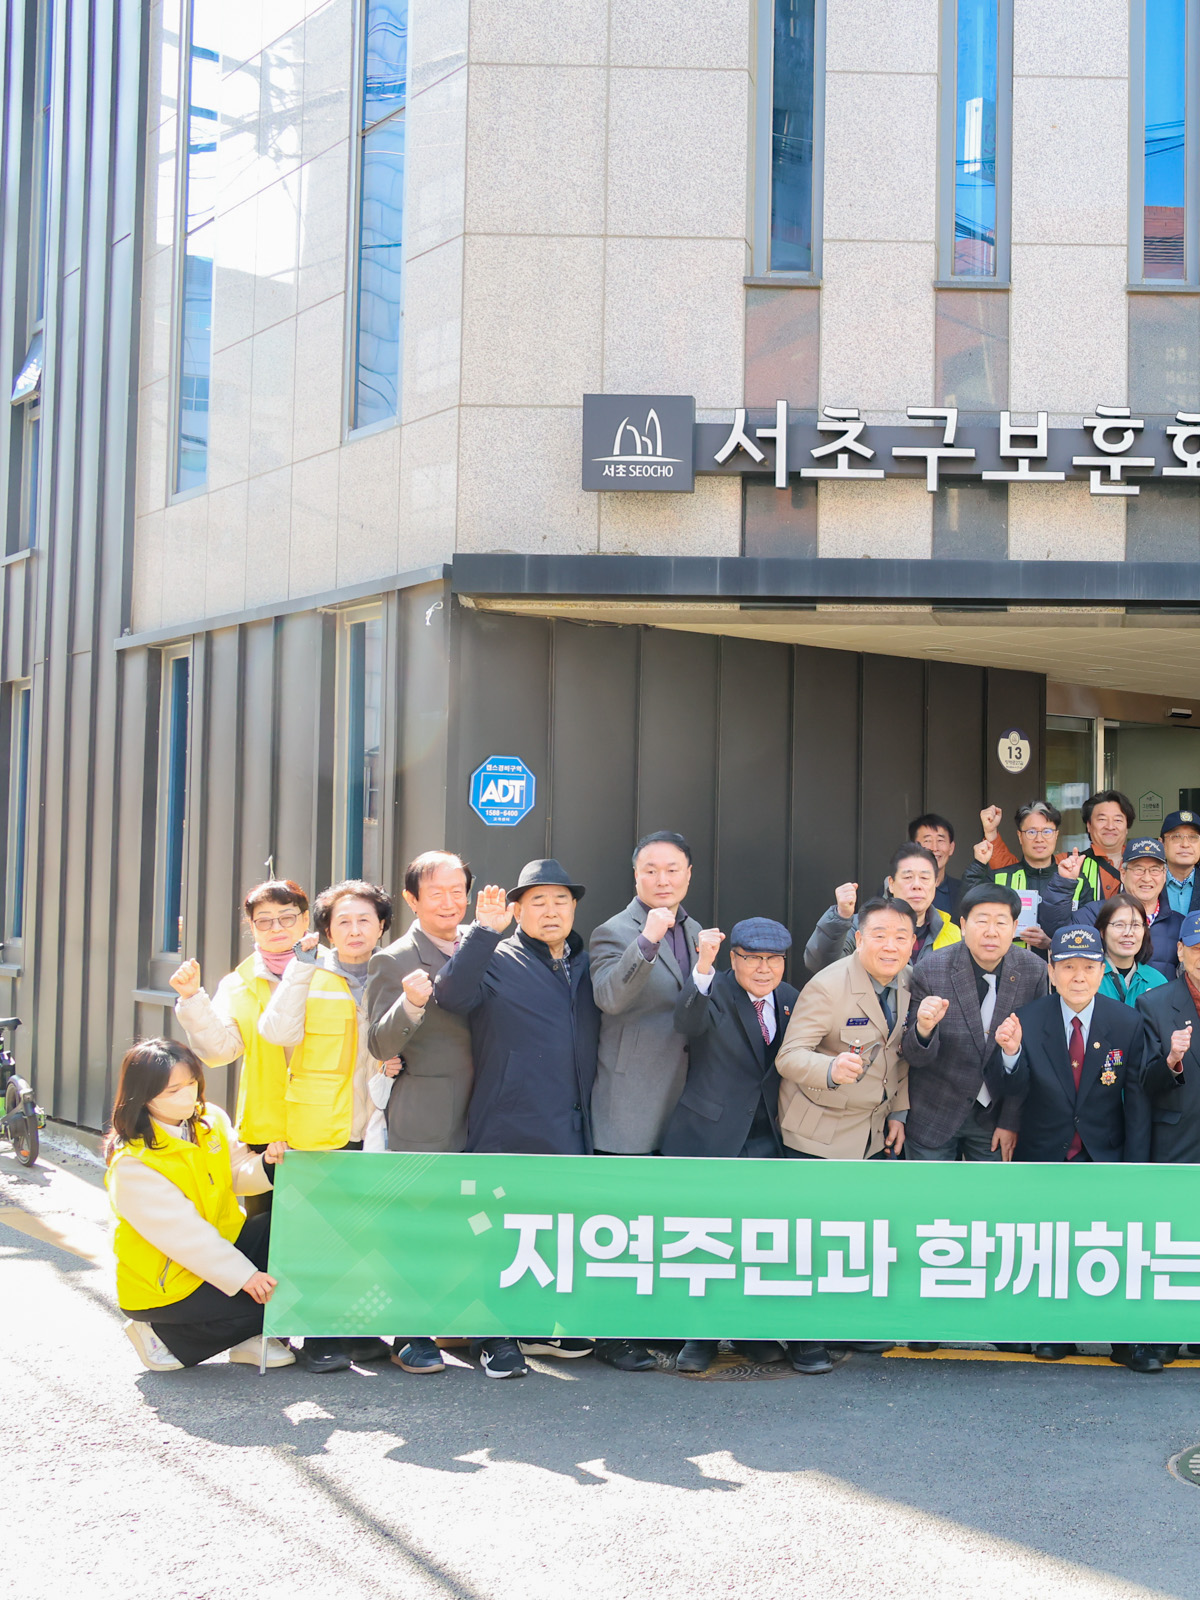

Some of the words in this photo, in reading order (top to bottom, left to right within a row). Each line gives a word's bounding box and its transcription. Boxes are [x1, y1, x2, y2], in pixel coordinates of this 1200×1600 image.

[602, 464, 627, 477] 서초
[628, 464, 674, 478] SEOCHO
[1007, 746, 1022, 760] 13
[480, 778, 525, 804] ADT
[500, 1213, 897, 1297] 지역주민과
